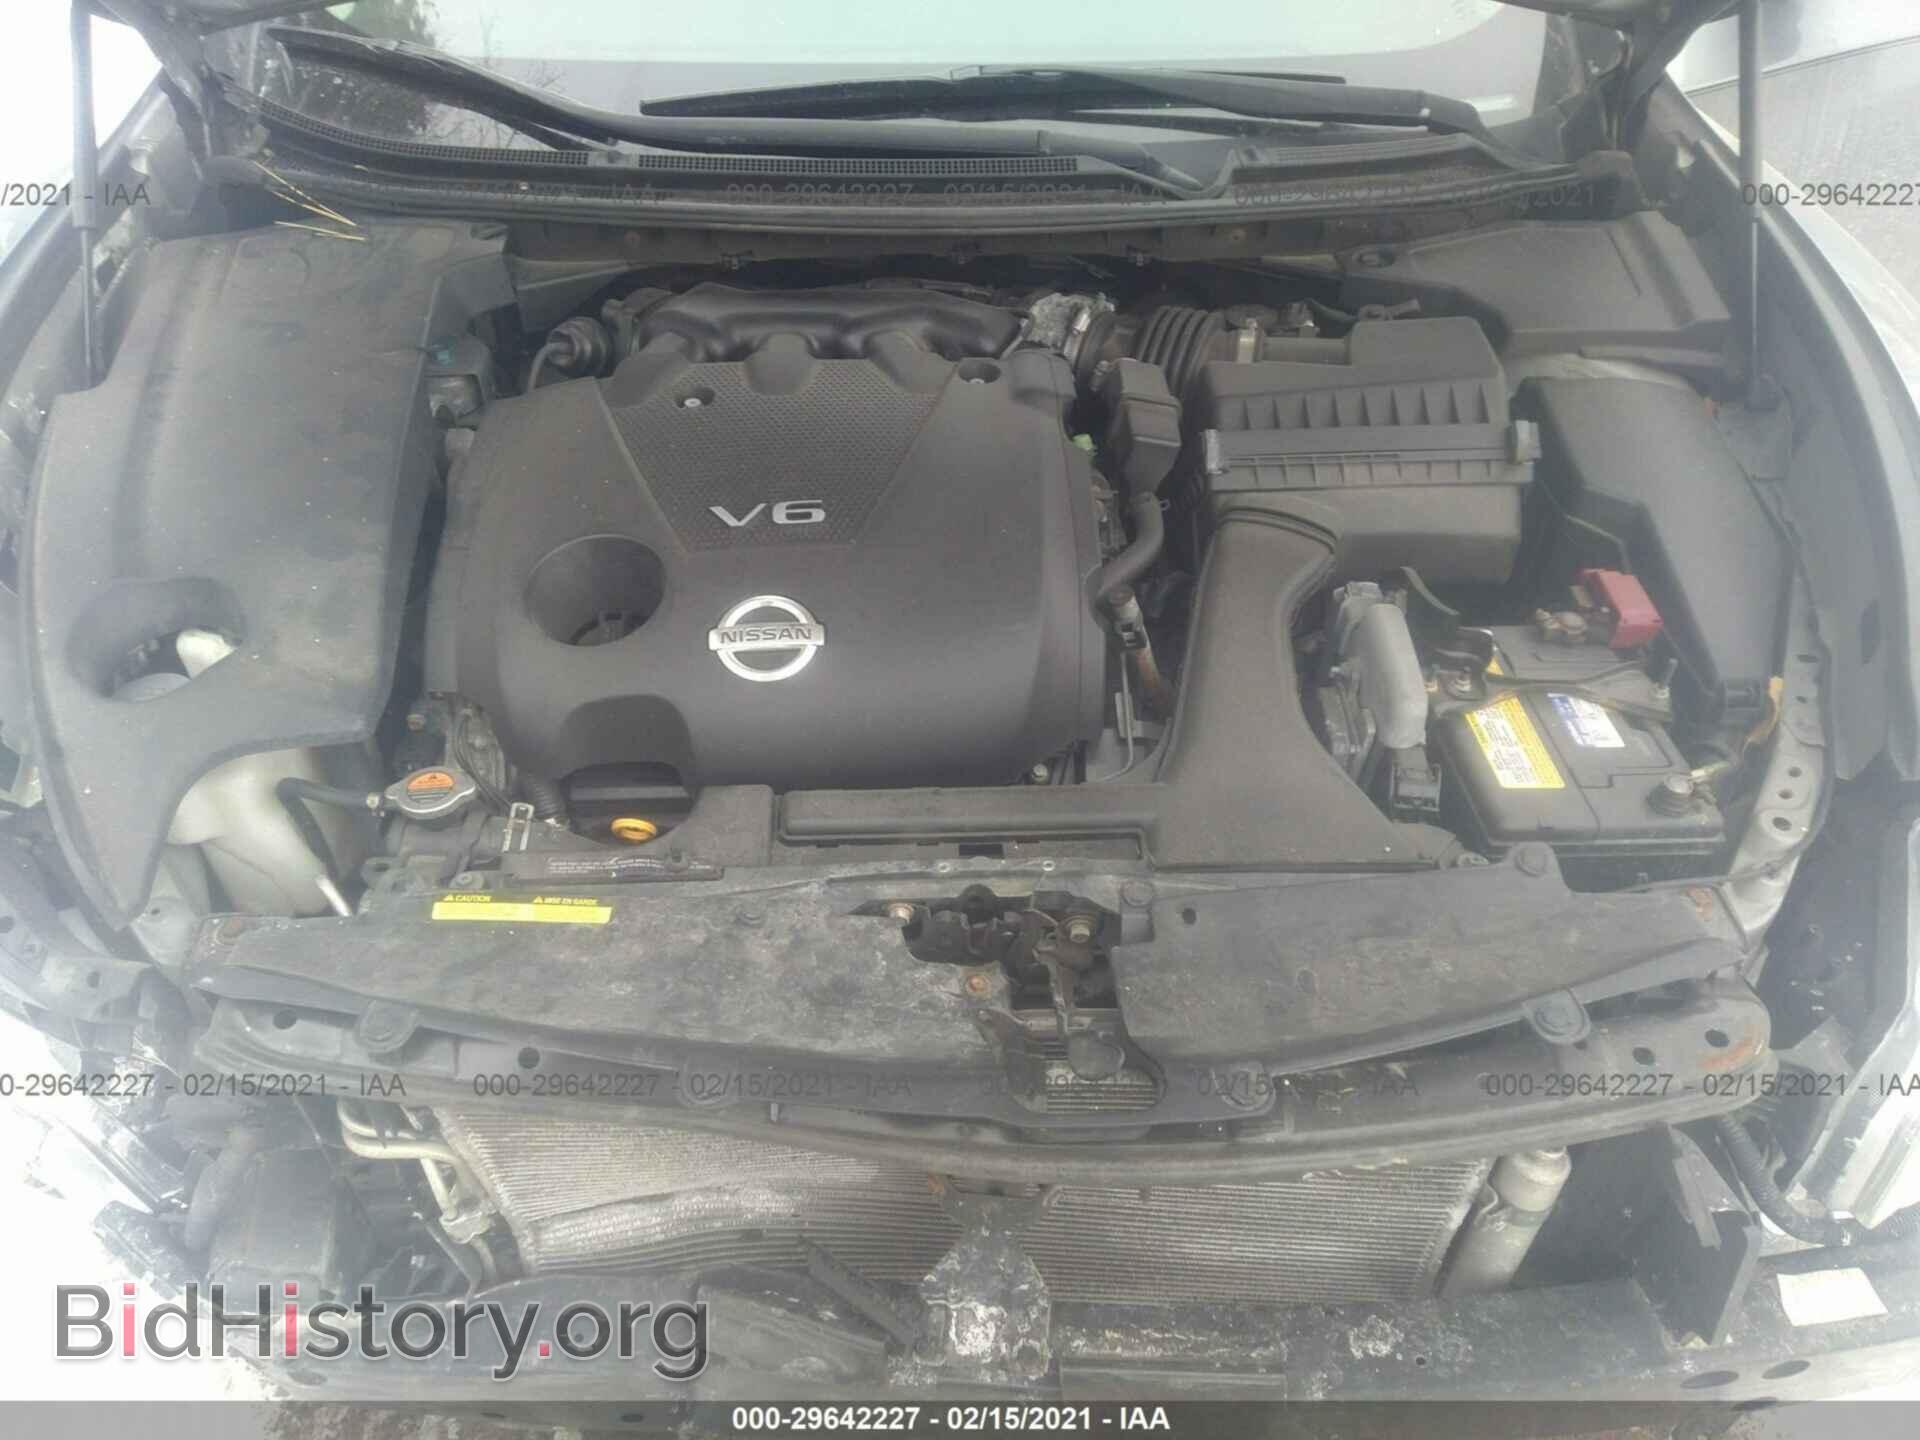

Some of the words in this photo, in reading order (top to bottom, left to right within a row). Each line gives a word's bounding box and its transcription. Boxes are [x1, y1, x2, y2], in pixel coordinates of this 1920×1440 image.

[708, 500, 826, 527] V6
[720, 628, 812, 644] NISSAN
[455, 895, 492, 903] CAUTION
